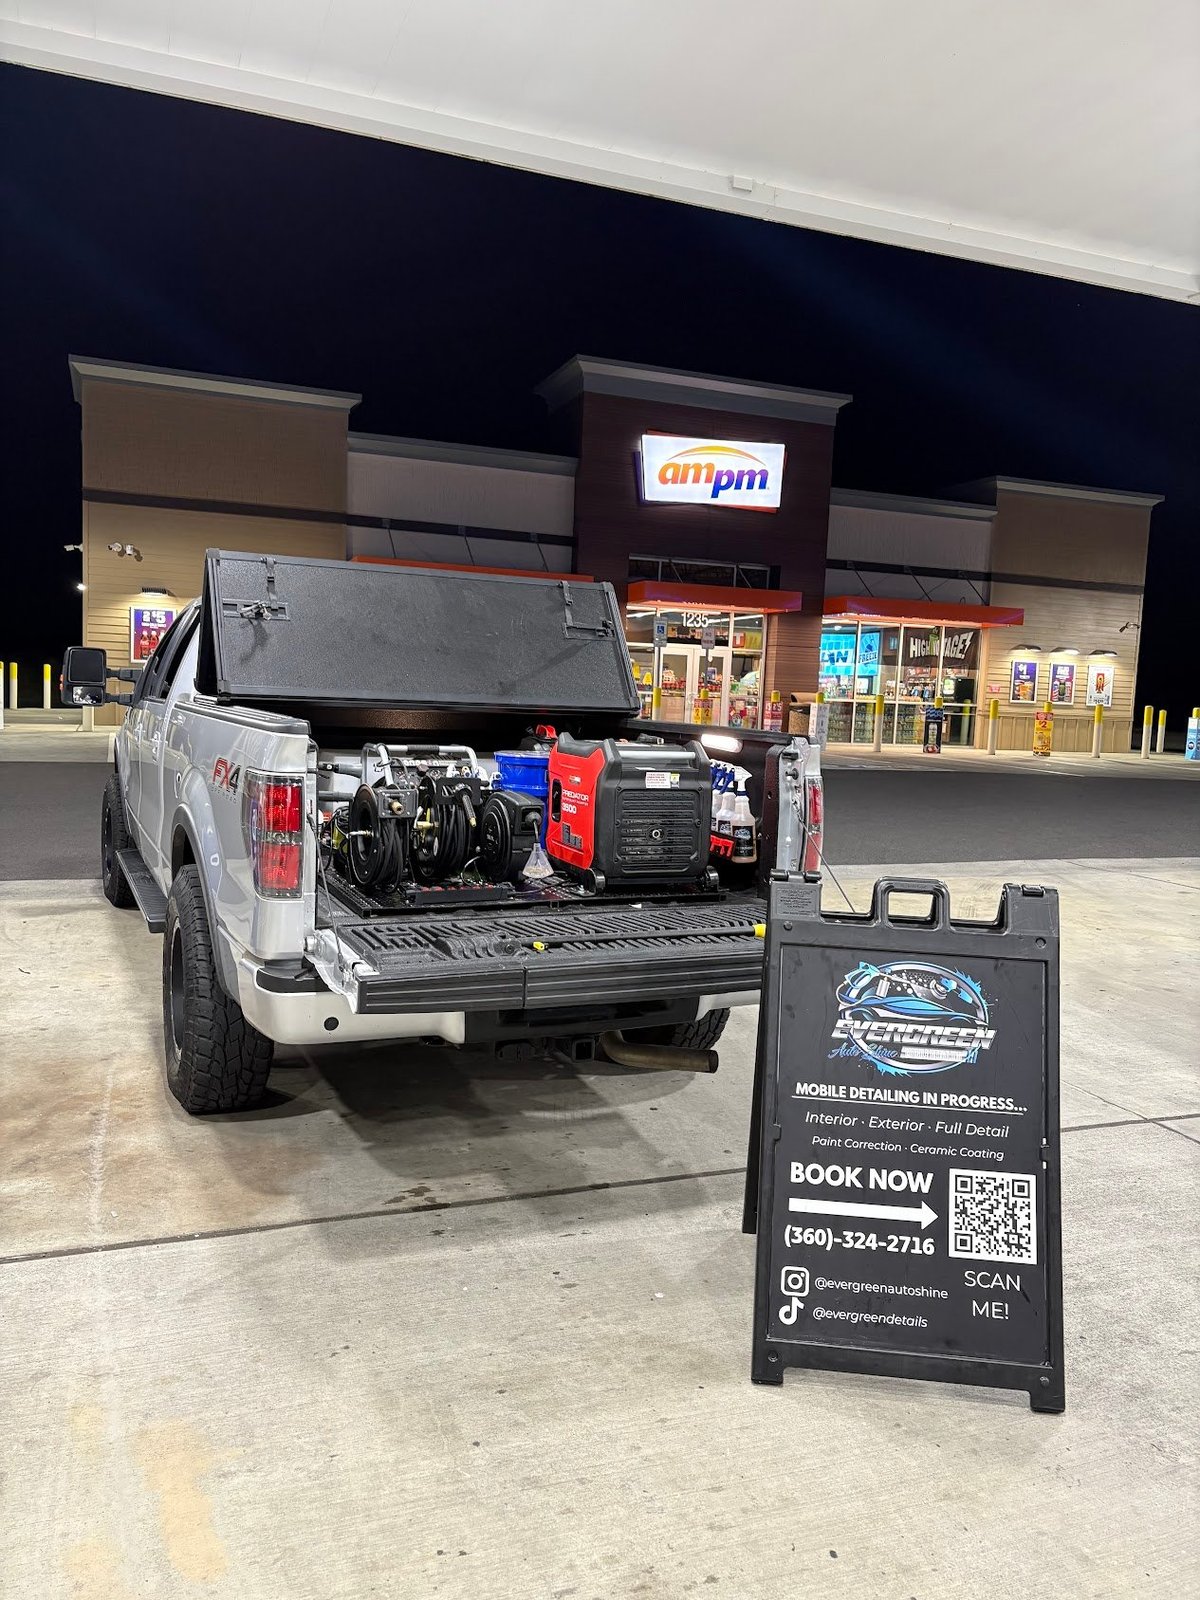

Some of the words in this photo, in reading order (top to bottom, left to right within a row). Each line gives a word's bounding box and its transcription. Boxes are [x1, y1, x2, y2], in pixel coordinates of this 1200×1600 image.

[658, 462, 769, 499] ampm
[681, 611, 709, 628] 1235
[213, 757, 241, 795] FX4
[562, 788, 590, 802] PREDATOR
[831, 1019, 998, 1050] EVERGREEN
[828, 1042, 861, 1059] Auto
[796, 1082, 847, 1099] MOBILE
[850, 1086, 921, 1104] DETAILING
[923, 1091, 938, 1106] IN
[941, 1092, 1028, 1112] PROGRESS...
[805, 1111, 859, 1127] Interior
[869, 1116, 926, 1132] Exterior
[935, 1120, 963, 1135] Full
[966, 1123, 1010, 1138] Detail
[812, 1135, 842, 1148] Paint
[844, 1138, 903, 1152] Correction
[910, 1143, 957, 1157] Ceramic
[960, 1147, 1005, 1162] Coating
[790, 1161, 864, 1189] BOOK
[869, 1166, 934, 1194] NOW
[784, 1224, 935, 1256] (360)-324-2716
[814, 1276, 949, 1299] @evergreenautoshine
[964, 1270, 1021, 1292] SCAN
[812, 1306, 928, 1328] @evergreendetails
[972, 1299, 1009, 1320] ME!
